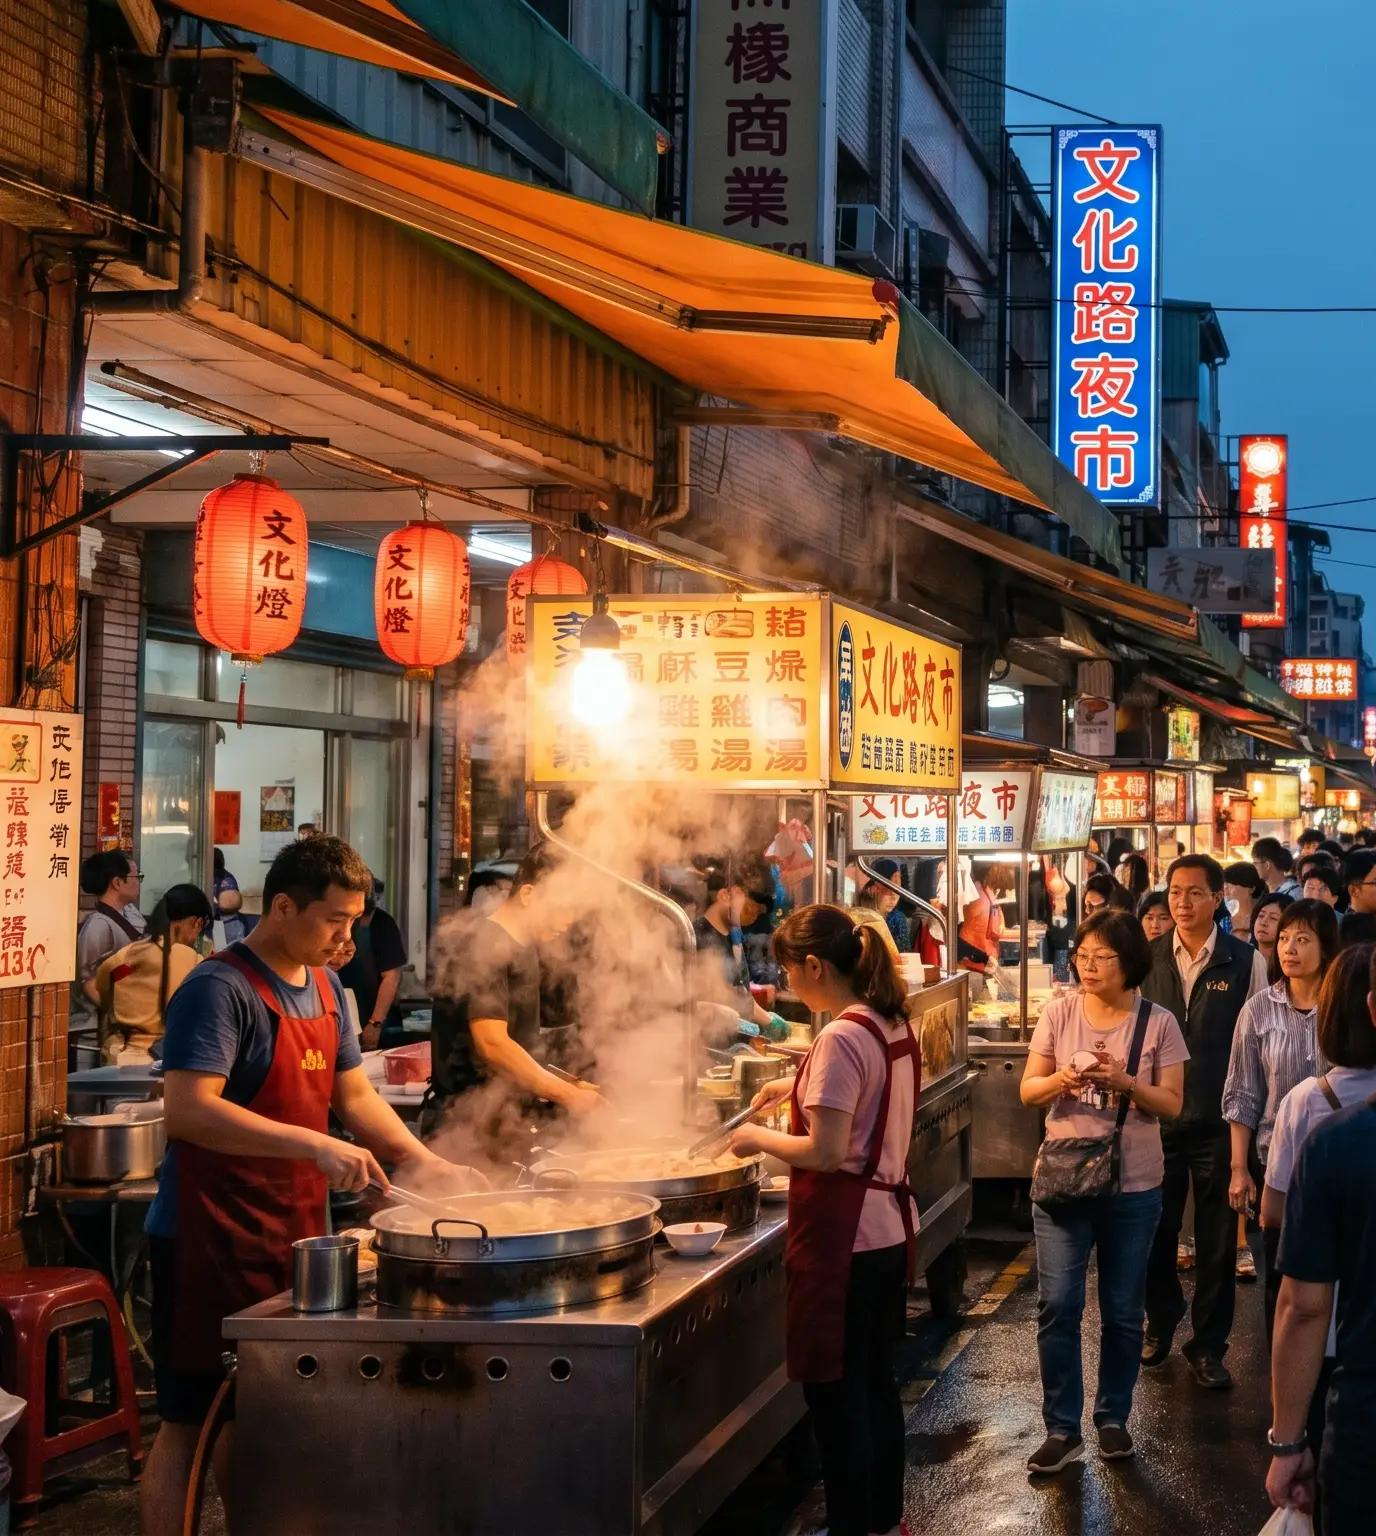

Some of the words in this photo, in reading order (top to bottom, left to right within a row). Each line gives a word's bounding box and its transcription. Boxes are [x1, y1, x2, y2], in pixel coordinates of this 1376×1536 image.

[1072, 139, 1140, 490] 文化路夜市
[254, 509, 298, 620] 文化燈
[384, 544, 416, 634] 文化燈
[860, 630, 955, 731] 文化路夜市
